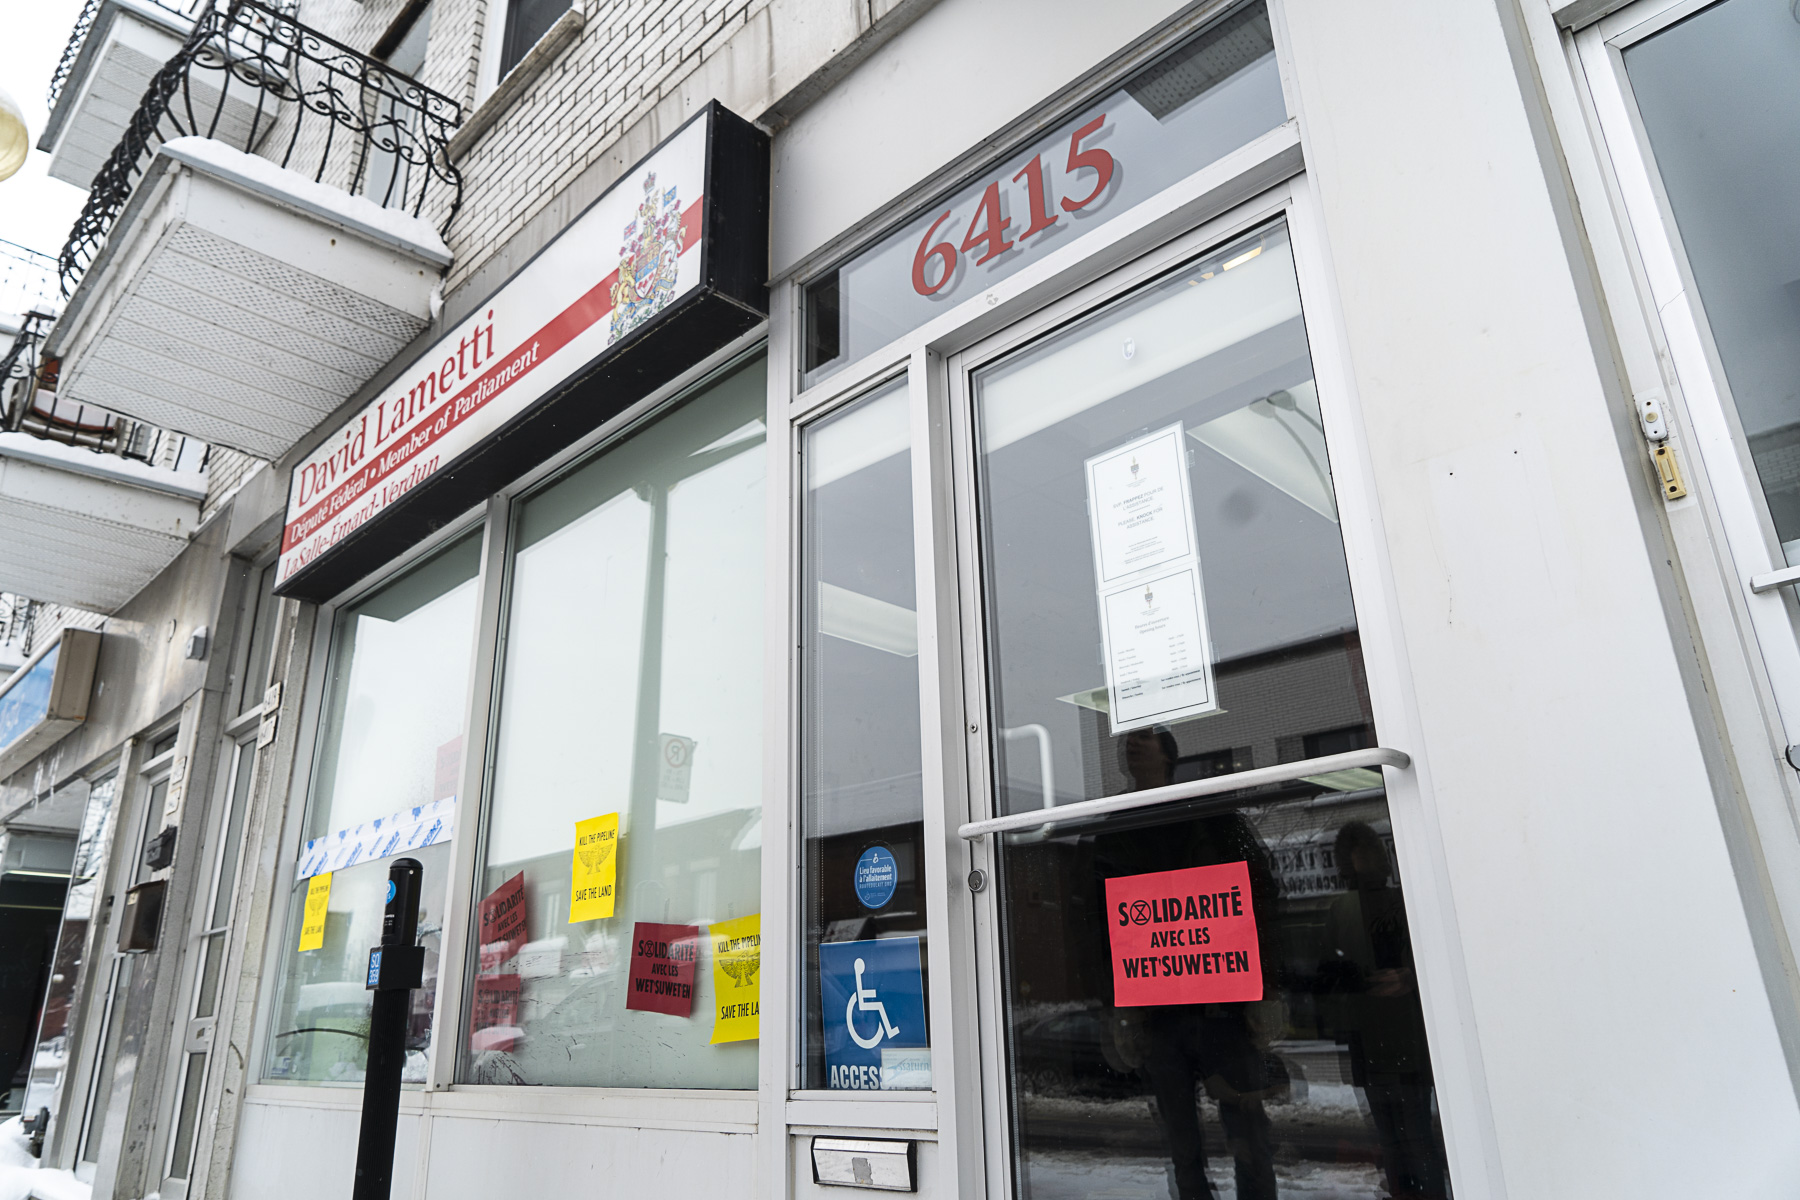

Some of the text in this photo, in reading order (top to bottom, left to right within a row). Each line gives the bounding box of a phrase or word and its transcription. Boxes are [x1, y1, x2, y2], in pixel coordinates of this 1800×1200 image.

[912, 113, 1114, 296] 6415
[298, 309, 495, 508] David Lametti
[290, 341, 540, 543] Député Fédéral Member of Parliament
[579, 829, 615, 847] KILL THE PIPELINE
[859, 864, 892, 875] Lieu favorable
[575, 884, 612, 902] SAVE THE LAND
[497, 910, 518, 933] AVEC LES
[718, 941, 730, 953] KILL
[730, 938, 740, 950] THE
[1150, 926, 1211, 949] AVEC LES
[651, 962, 679, 977] AVEC LES
[1122, 950, 1249, 979] WET'SUWET'EN
[721, 1004, 736, 1020] SAVE
[737, 1003, 750, 1018] THE
